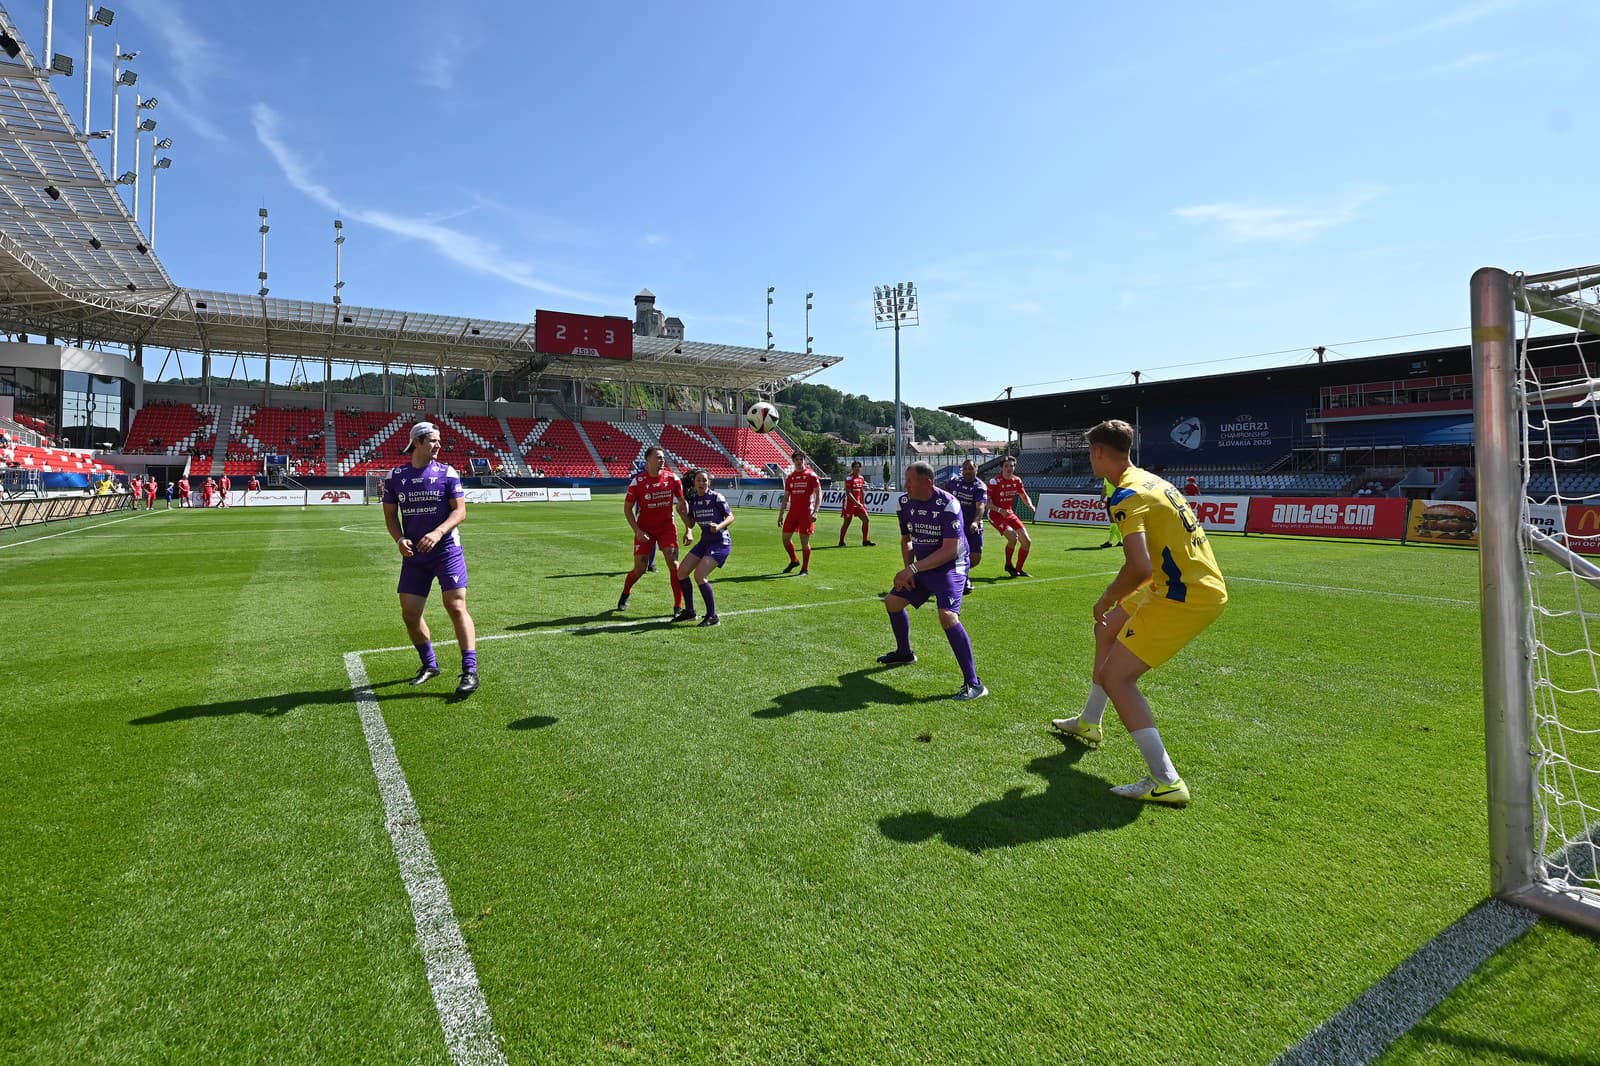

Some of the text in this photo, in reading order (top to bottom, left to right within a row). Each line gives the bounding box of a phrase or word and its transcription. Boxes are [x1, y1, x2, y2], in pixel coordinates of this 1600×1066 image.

[556, 325, 566, 339] 2
[605, 330, 614, 344] 3
[1220, 422, 1269, 432] UNDER21
[1220, 431, 1269, 439] CHAMPIONSHIP
[506, 490, 538, 500] Zoznam
